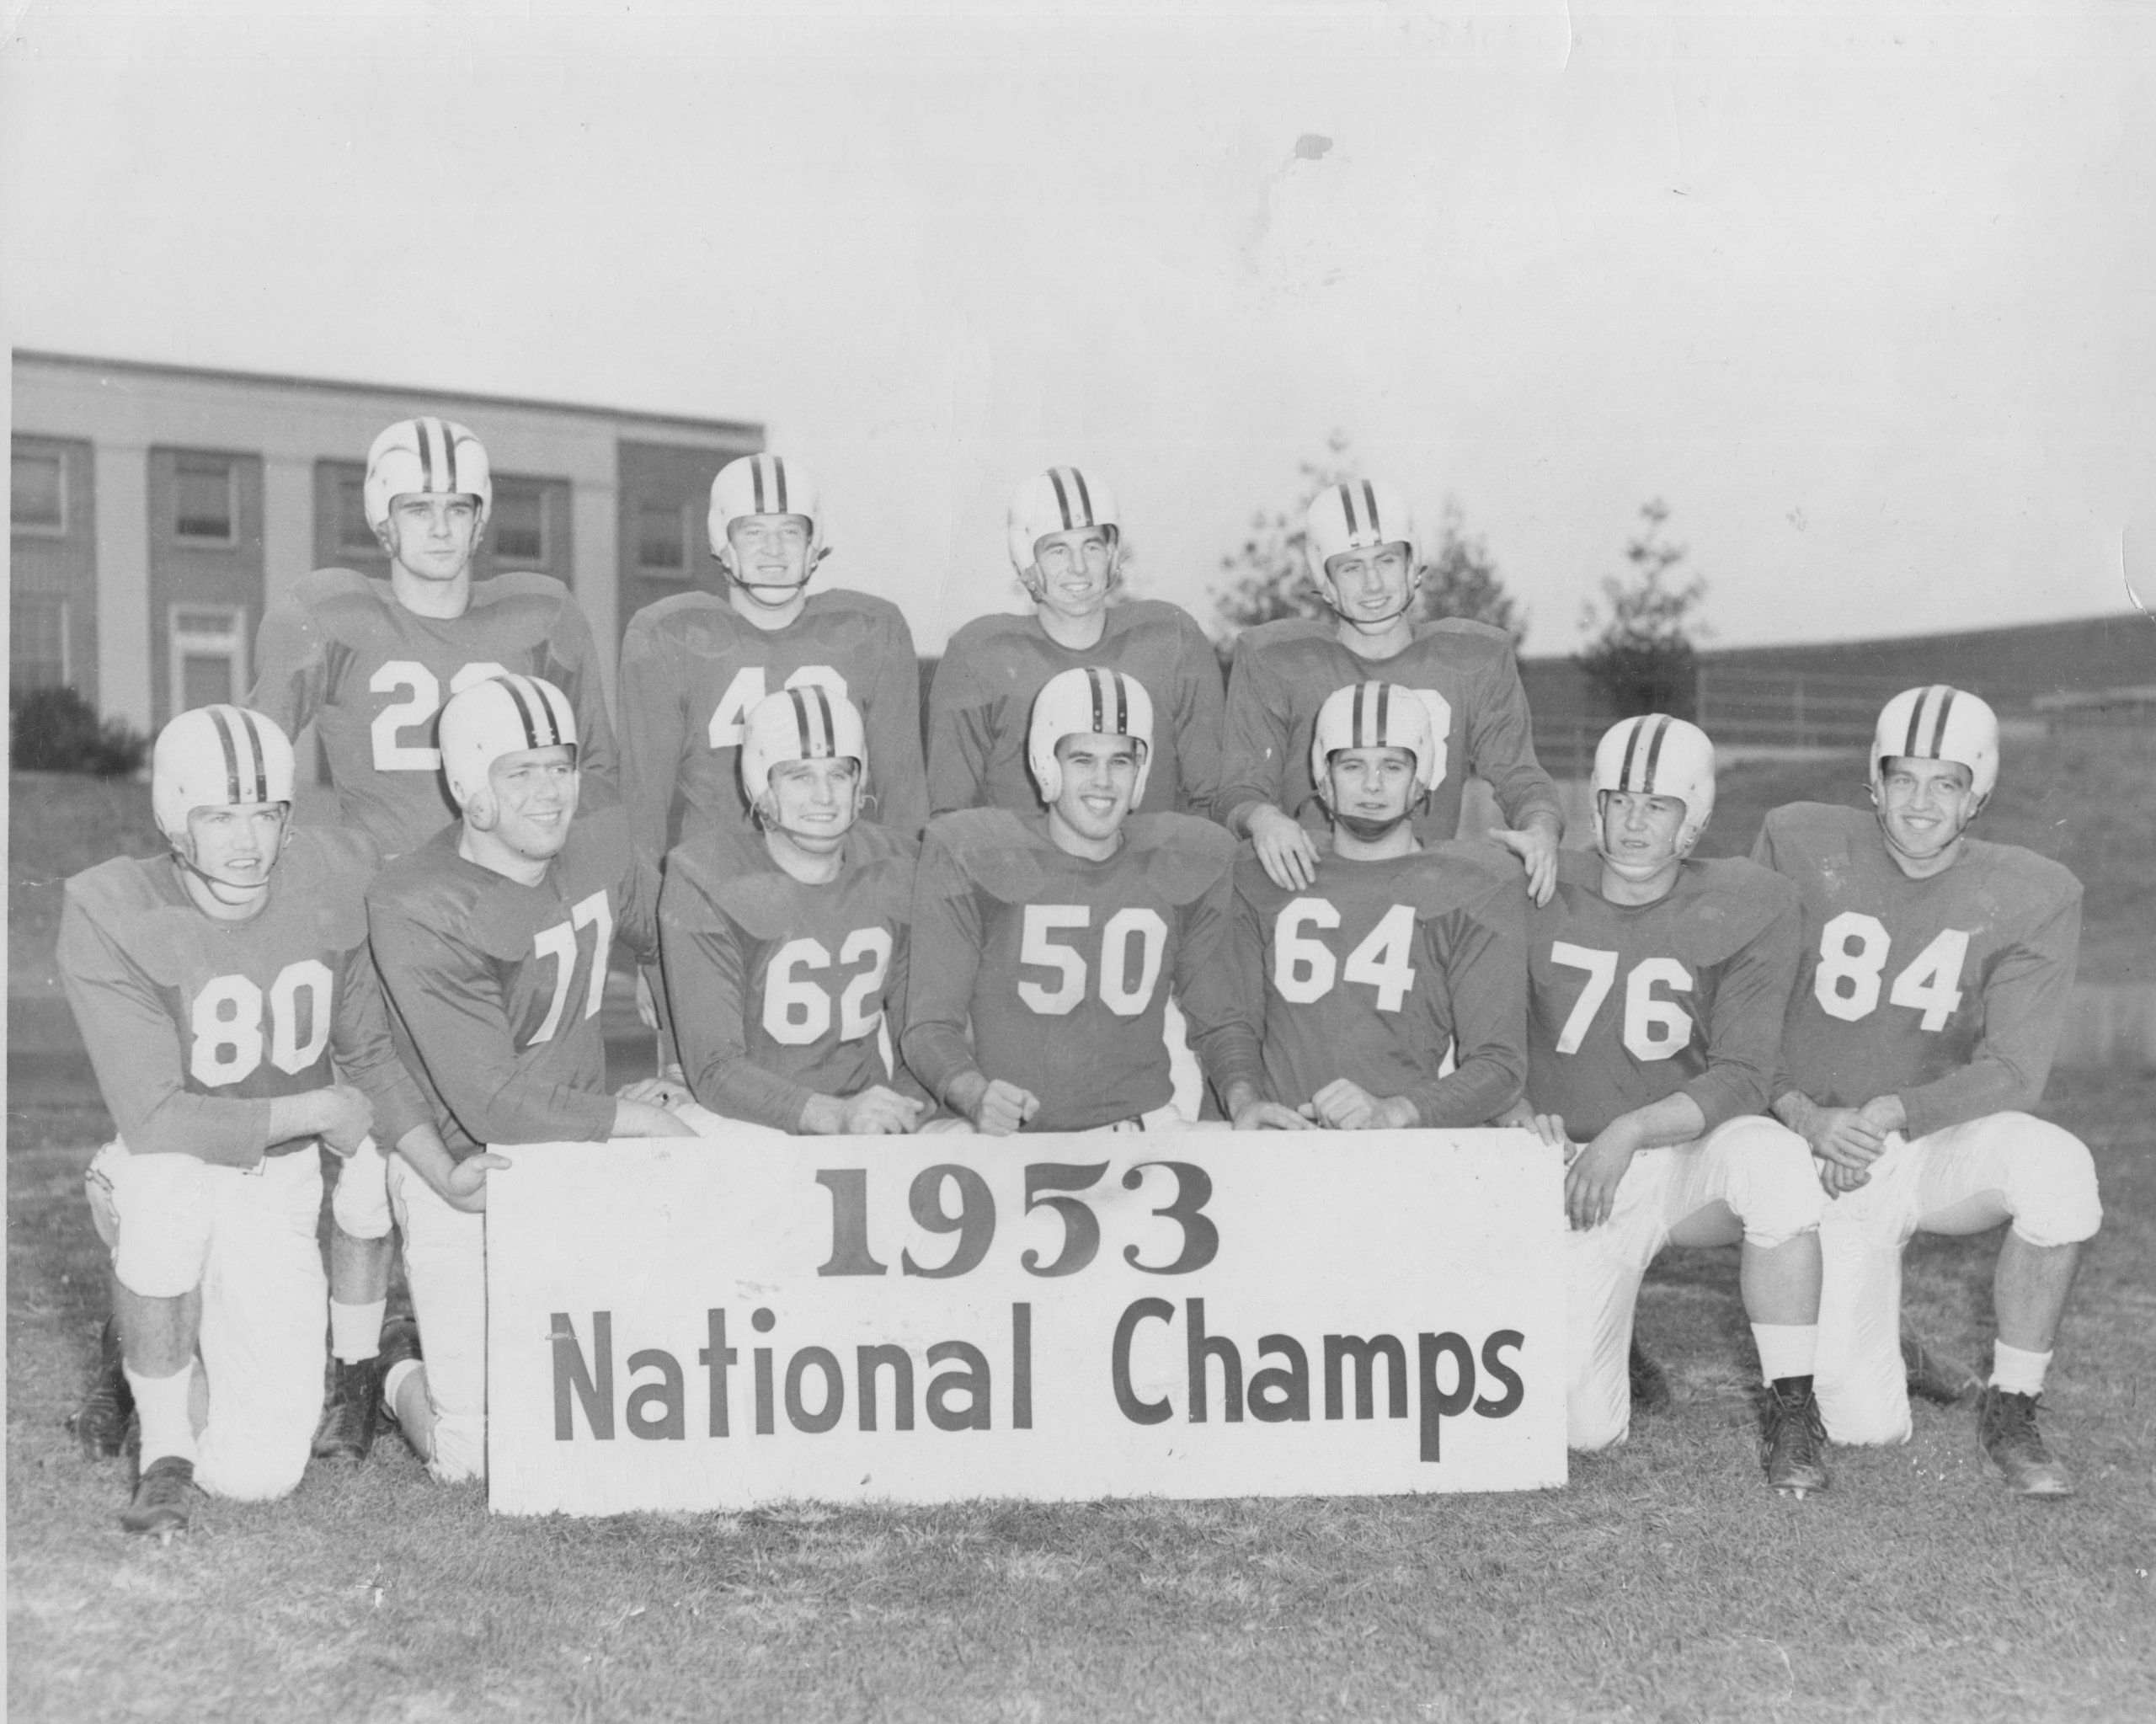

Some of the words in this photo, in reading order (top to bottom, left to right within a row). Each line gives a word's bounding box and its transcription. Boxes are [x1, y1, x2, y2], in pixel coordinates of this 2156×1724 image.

[526, 889, 612, 1046] 77
[763, 926, 893, 1045] 62
[1018, 905, 1168, 1016] 50
[1273, 897, 1416, 1012] 64
[1550, 940, 1693, 1061] 76
[1814, 911, 1969, 1032] 84
[190, 958, 334, 1087] 80
[816, 1160, 1219, 1279] 1953
[551, 1302, 1033, 1441] National
[1112, 1297, 1526, 1463] Champs
